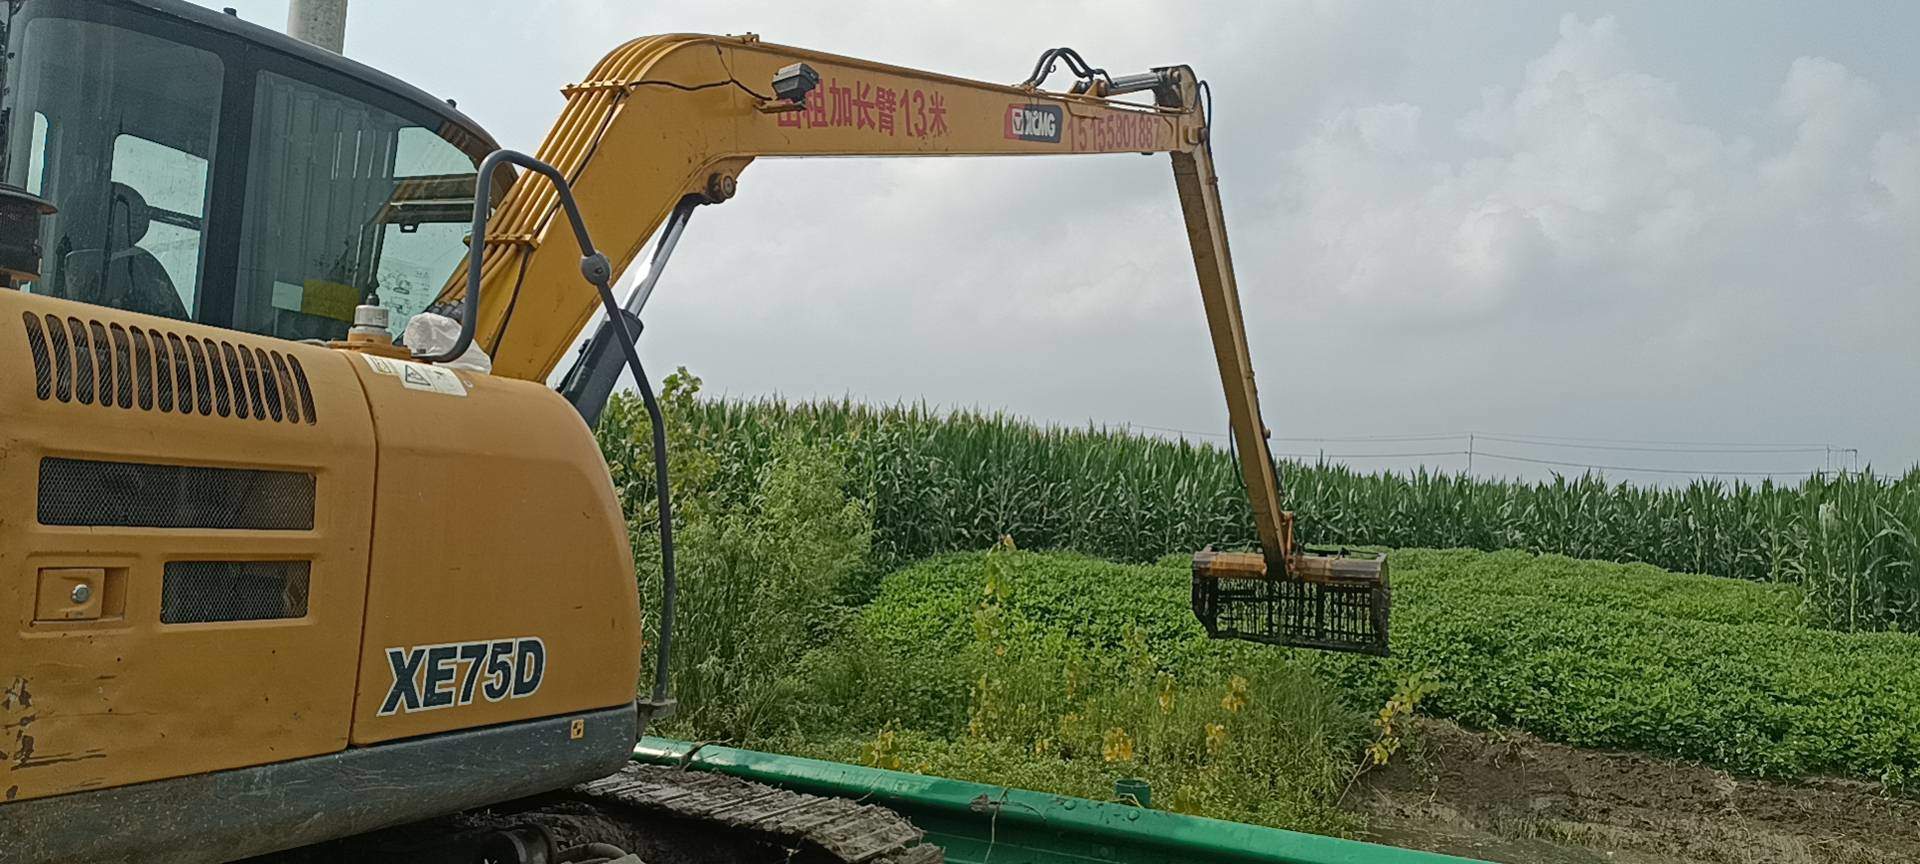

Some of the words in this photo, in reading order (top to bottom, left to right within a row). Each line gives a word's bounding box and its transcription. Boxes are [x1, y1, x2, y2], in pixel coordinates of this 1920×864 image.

[1025, 110, 1056, 137] XCMG
[1067, 114, 1160, 151] 15155801887
[376, 636, 546, 717] XE75D
